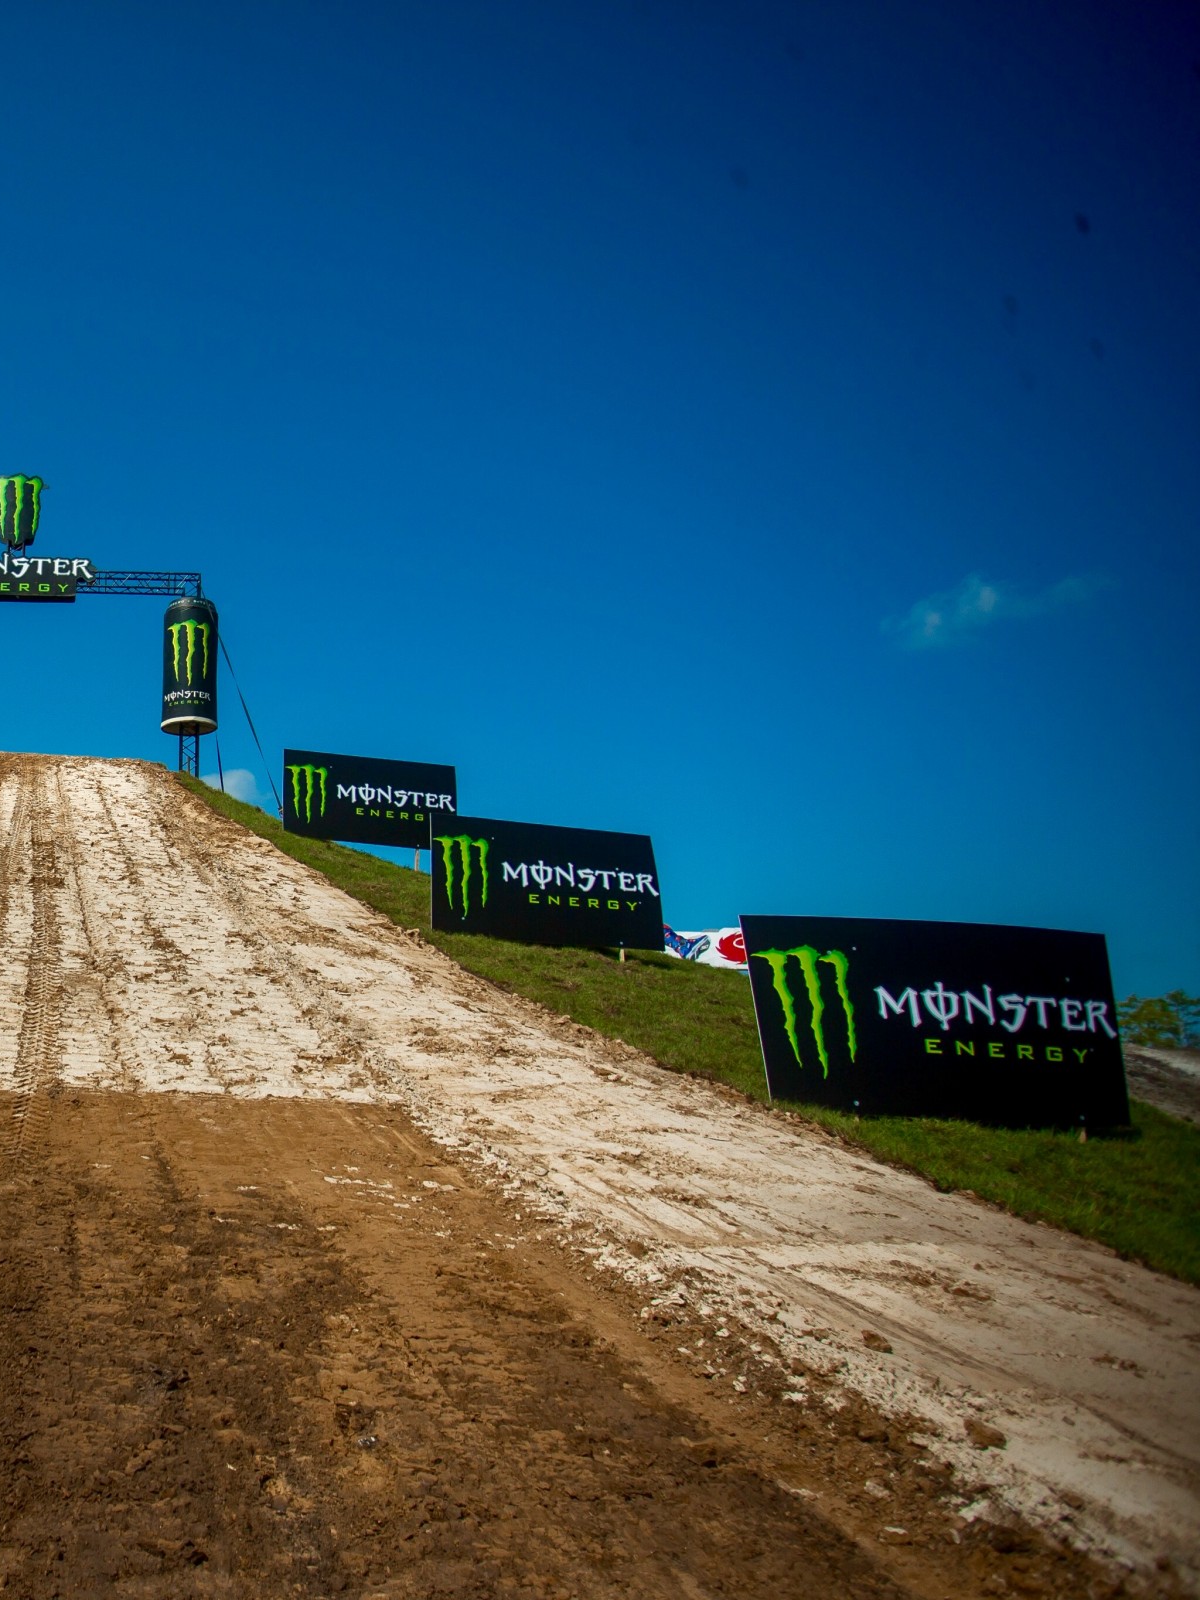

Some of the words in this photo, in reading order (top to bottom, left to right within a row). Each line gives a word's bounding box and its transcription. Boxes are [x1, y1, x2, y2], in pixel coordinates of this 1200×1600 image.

[164, 689, 211, 702] MONSTER
[169, 699, 205, 707] ENERGY
[336, 783, 456, 813] MONSTER
[355, 807, 425, 822] ENERG
[501, 860, 660, 897] MONSTER
[528, 893, 638, 911] ENERGY
[873, 981, 1117, 1039] MONSTER
[924, 1037, 1087, 1064] ENERGY
